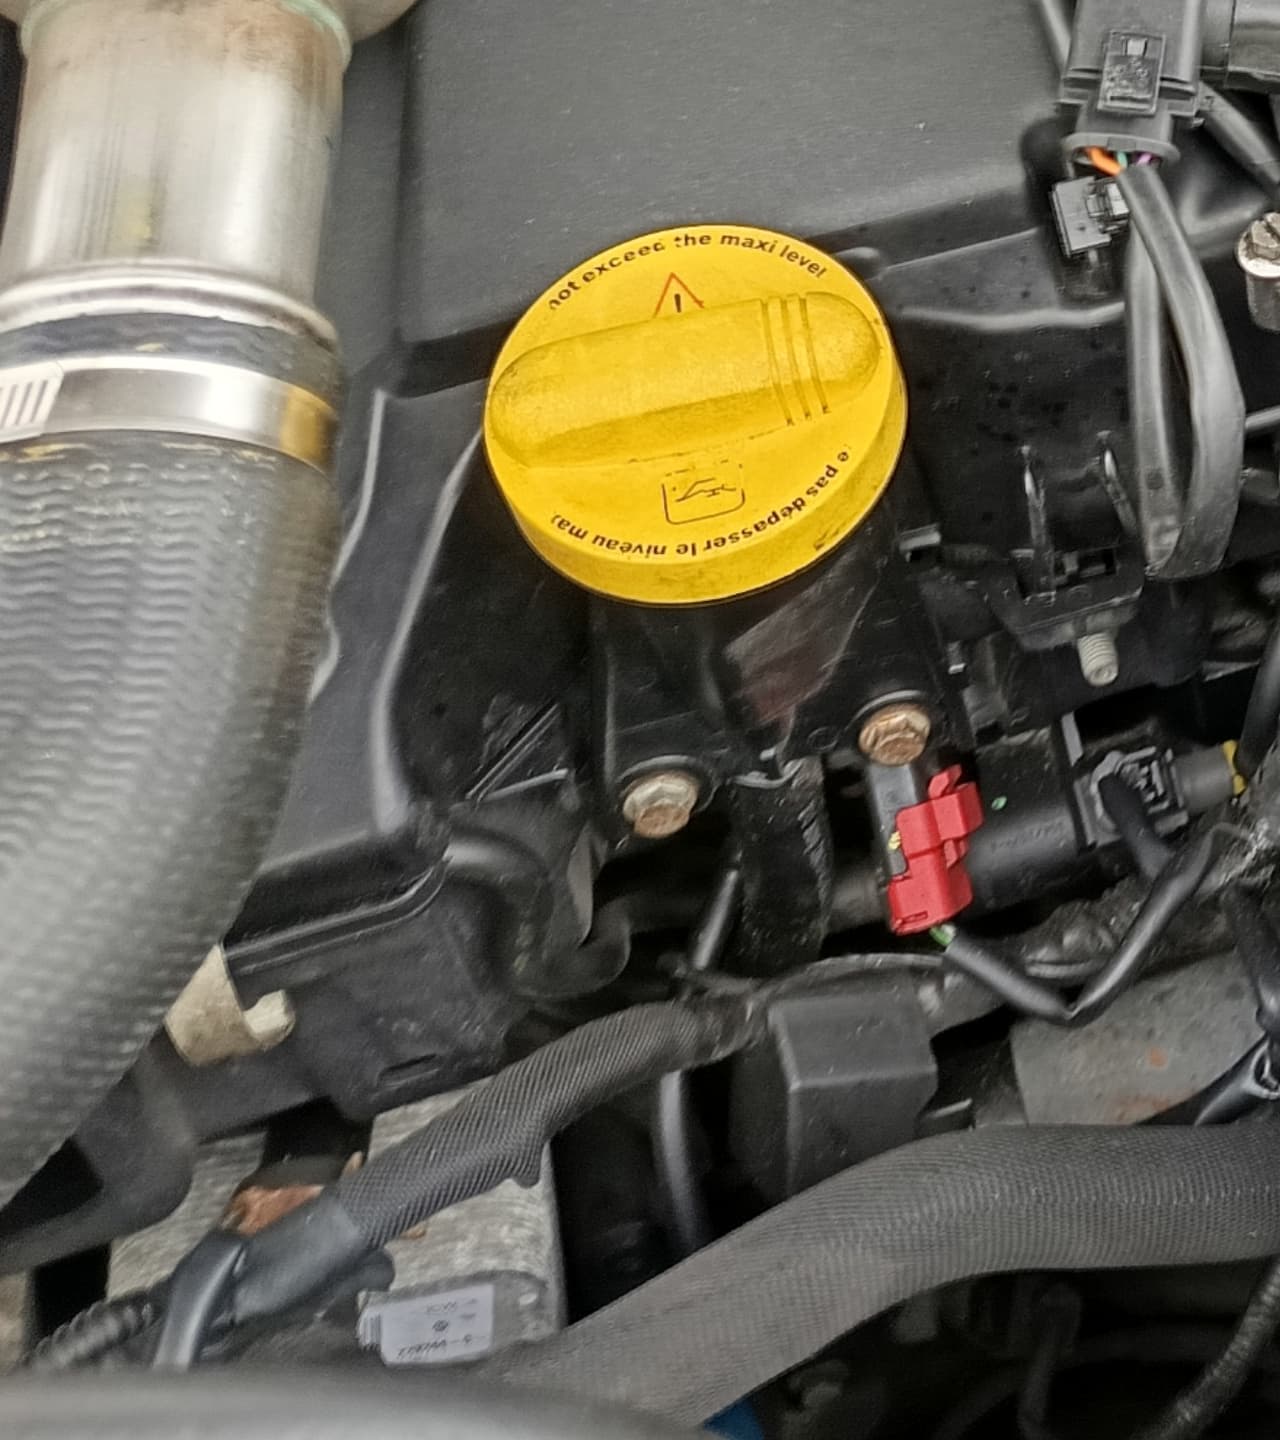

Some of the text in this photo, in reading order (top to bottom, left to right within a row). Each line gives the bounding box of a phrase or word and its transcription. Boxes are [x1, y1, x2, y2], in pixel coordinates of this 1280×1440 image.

[719, 234, 777, 255] maxi
[780, 246, 827, 279] level
[806, 466, 840, 499] pas
[702, 496, 807, 559] dépasser
[592, 532, 667, 559] niveau
[676, 542, 697, 557] le
